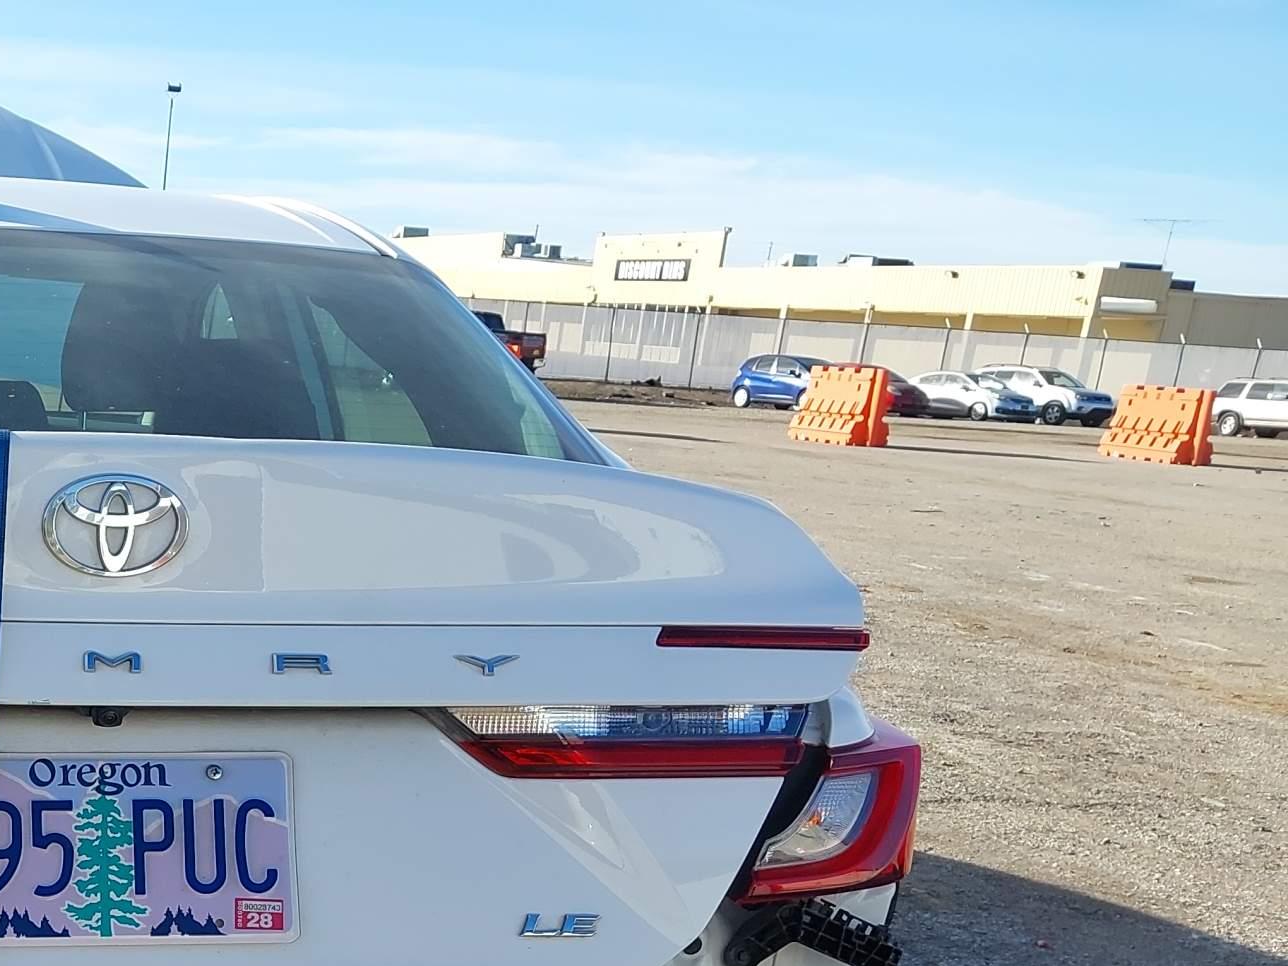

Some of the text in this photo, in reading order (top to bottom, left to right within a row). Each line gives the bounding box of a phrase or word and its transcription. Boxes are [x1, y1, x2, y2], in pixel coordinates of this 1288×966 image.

[28, 757, 172, 796] Oregon
[133, 799, 279, 895] PUC
[246, 912, 273, 928] 28
[519, 911, 601, 938] LE
